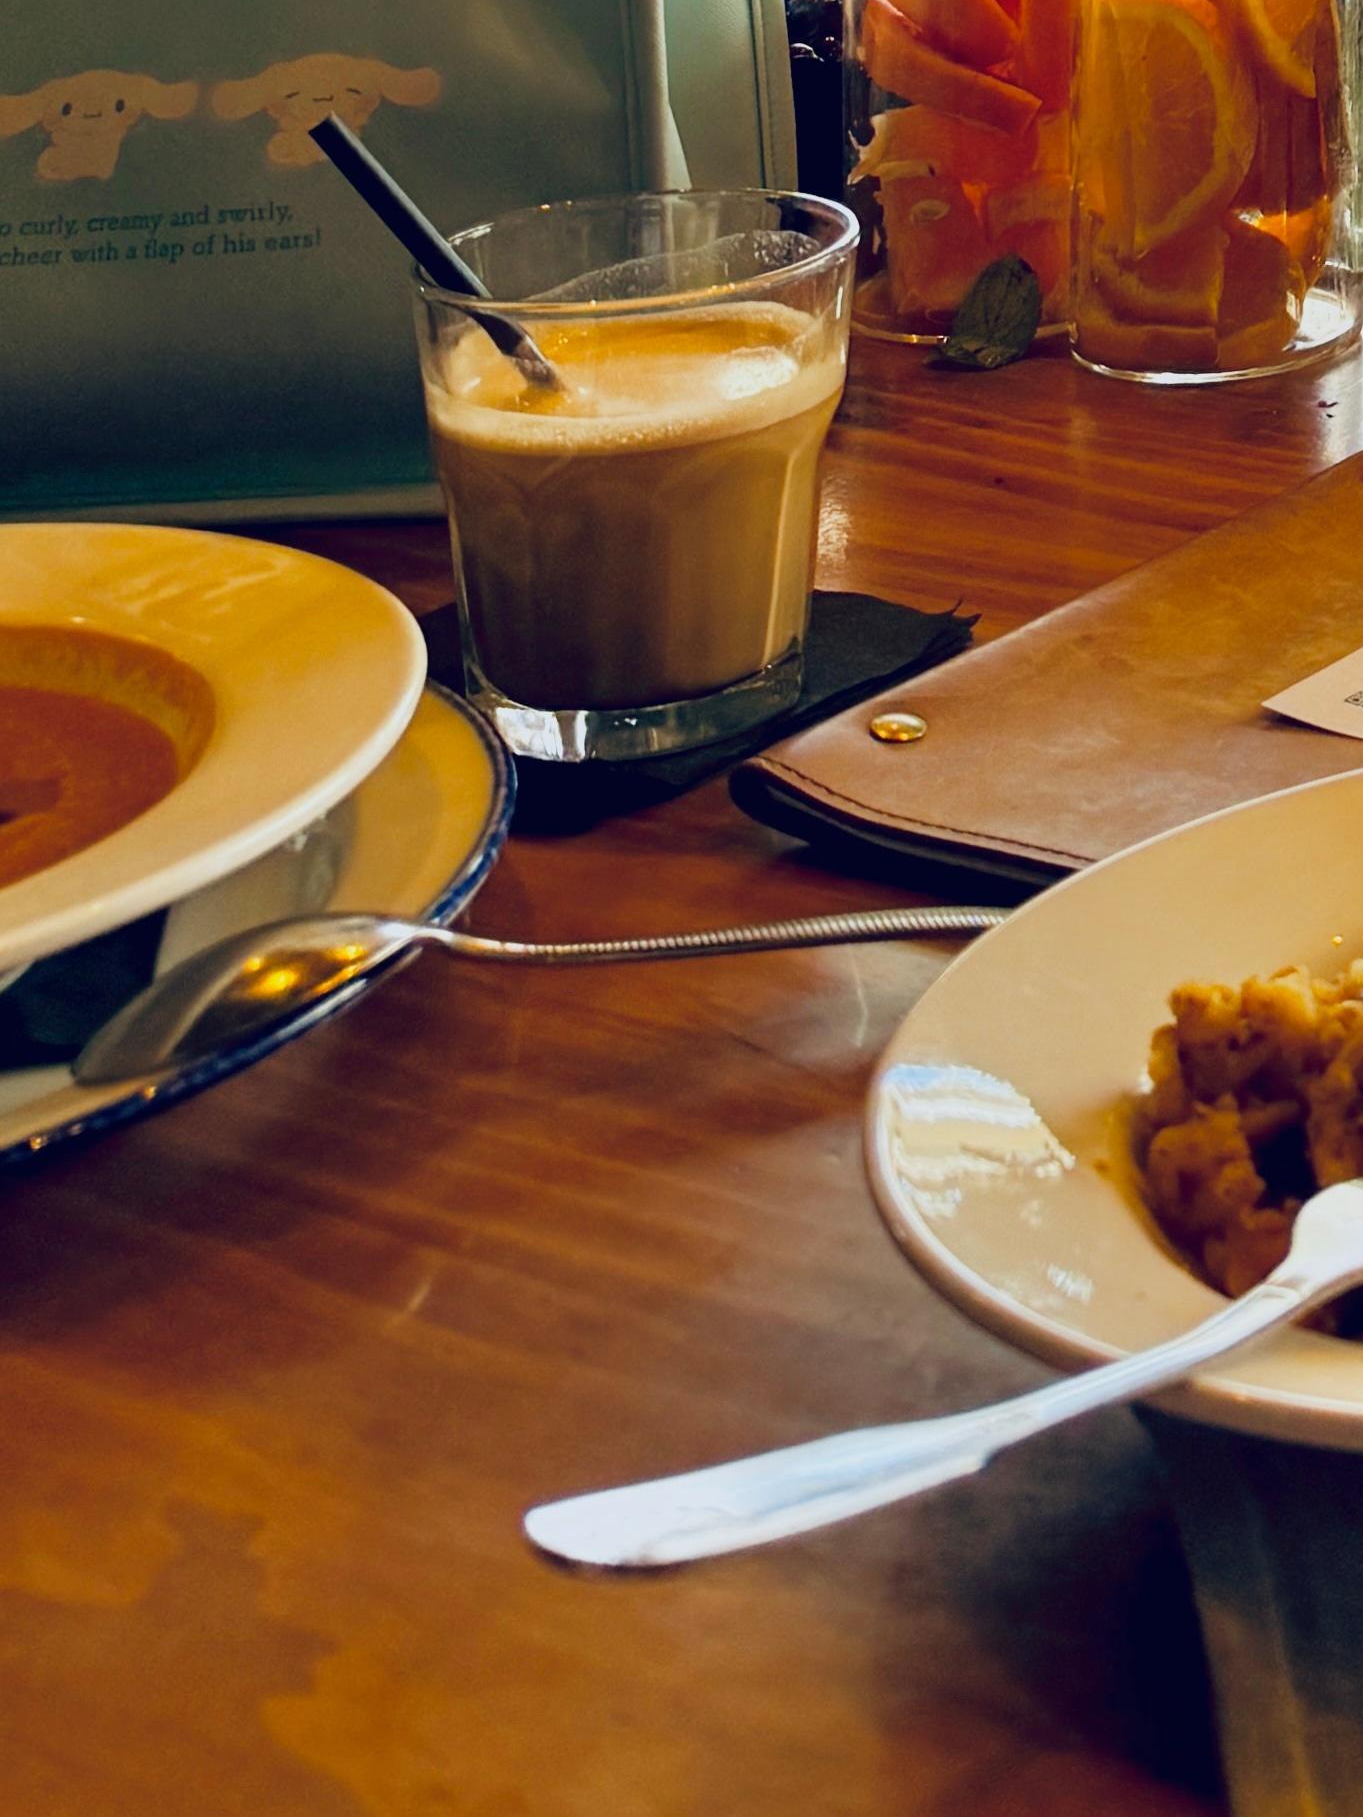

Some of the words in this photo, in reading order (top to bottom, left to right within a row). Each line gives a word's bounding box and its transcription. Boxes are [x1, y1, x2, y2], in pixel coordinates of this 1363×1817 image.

[86, 214, 163, 235] creamy
[169, 205, 210, 227] and
[70, 242, 119, 263] with
[126, 246, 137, 259] a
[144, 239, 185, 265] flap
[191, 234, 215, 257] of
[222, 233, 257, 254] his
[264, 226, 322, 252] ears!
